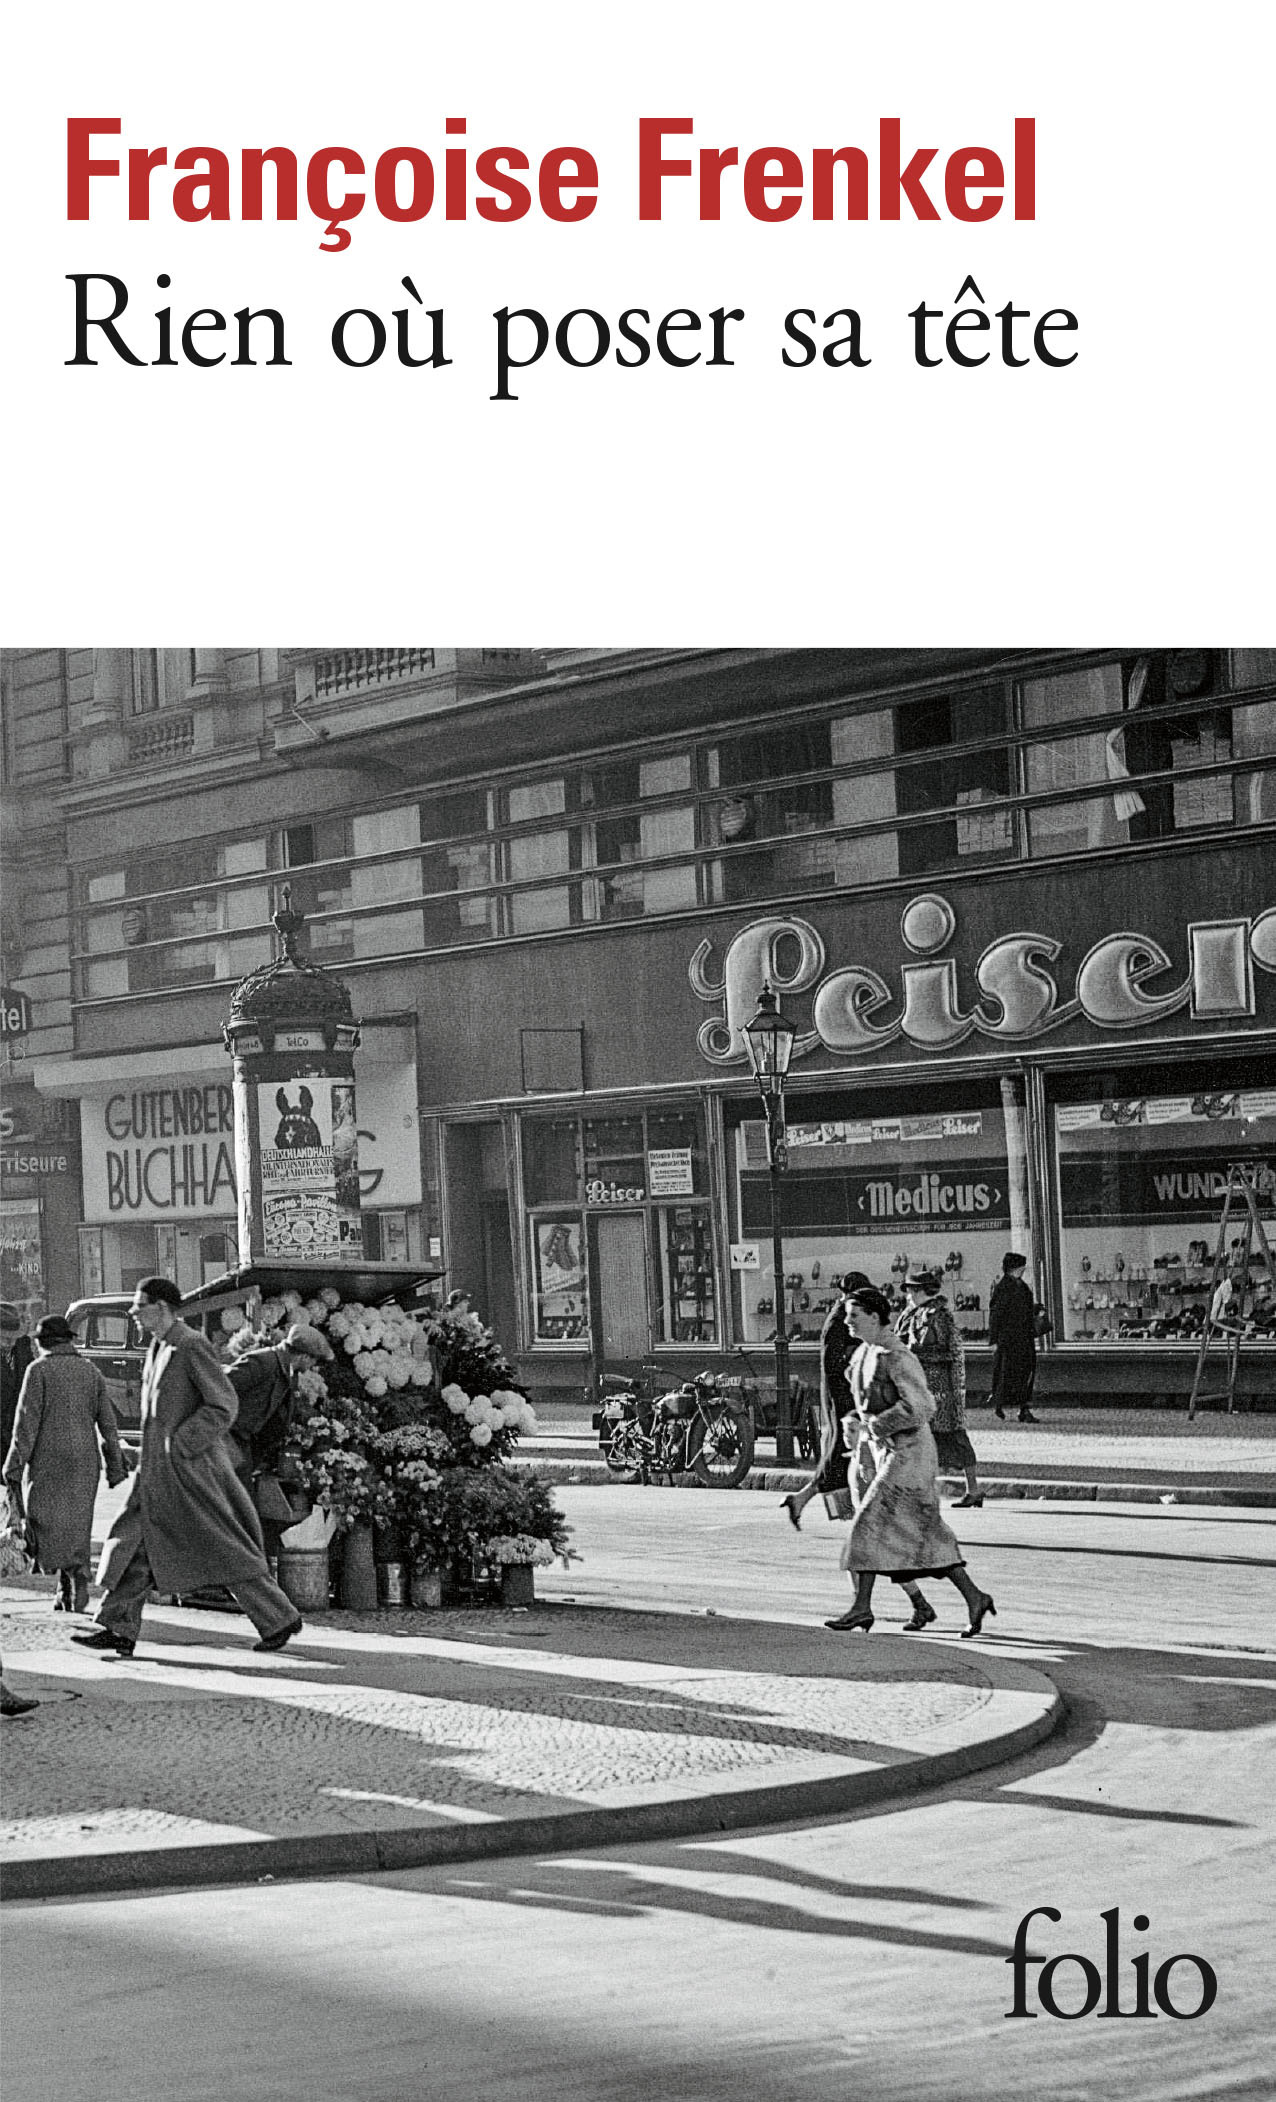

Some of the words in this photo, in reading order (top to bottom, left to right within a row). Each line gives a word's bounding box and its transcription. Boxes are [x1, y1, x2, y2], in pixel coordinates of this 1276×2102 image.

[688, 892, 1276, 1066] Leiser
[105, 1084, 233, 1141] GUTENBER
[586, 1180, 645, 1203] Leiser
